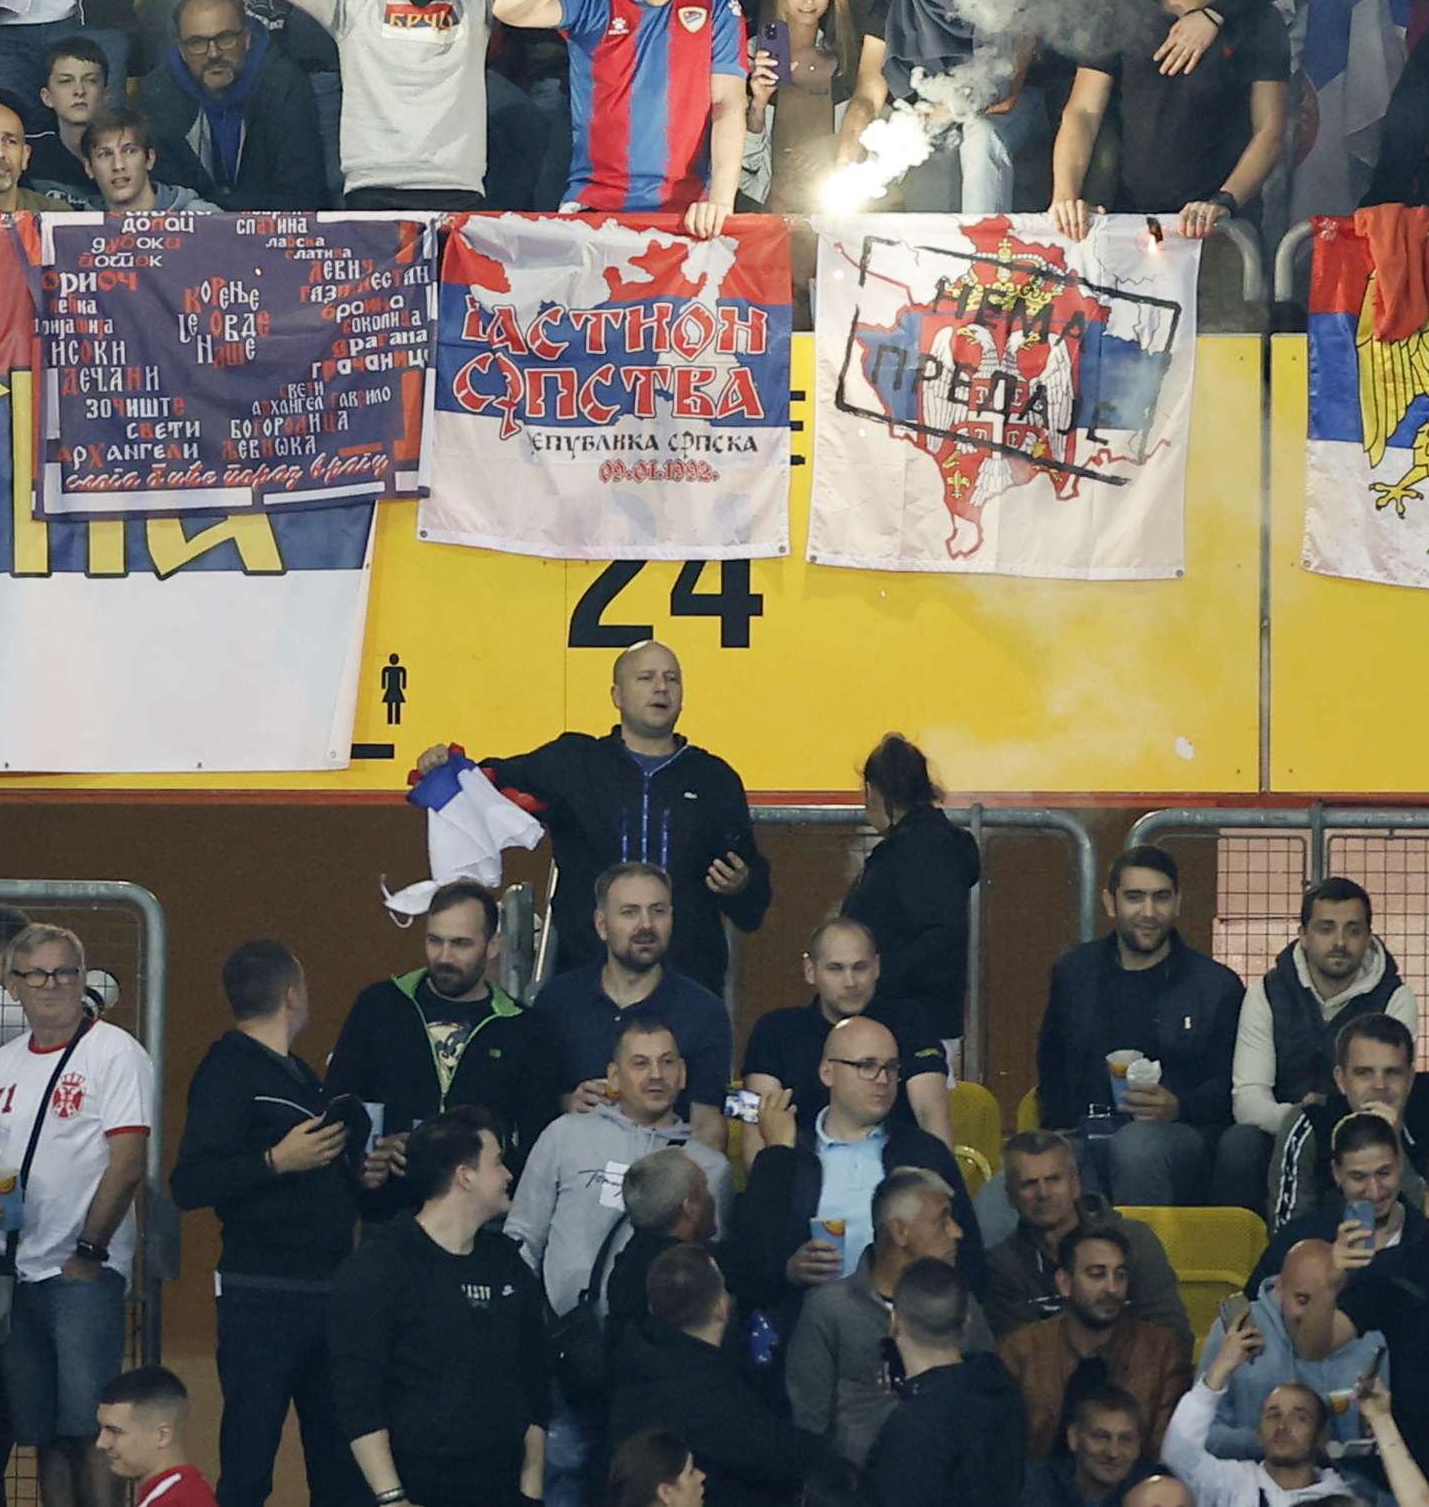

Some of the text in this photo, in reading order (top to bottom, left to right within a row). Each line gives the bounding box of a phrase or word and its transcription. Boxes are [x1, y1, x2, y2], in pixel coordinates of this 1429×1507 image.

[121, 217, 195, 236] долац
[51, 339, 126, 366] ИСОКИ
[332, 329, 429, 359] драгана
[934, 276, 1085, 359] НЕМА
[452, 350, 764, 439] СРПСТВА
[870, 344, 1113, 447] ПРЕДАЈЕ
[567, 558, 764, 650] 24
